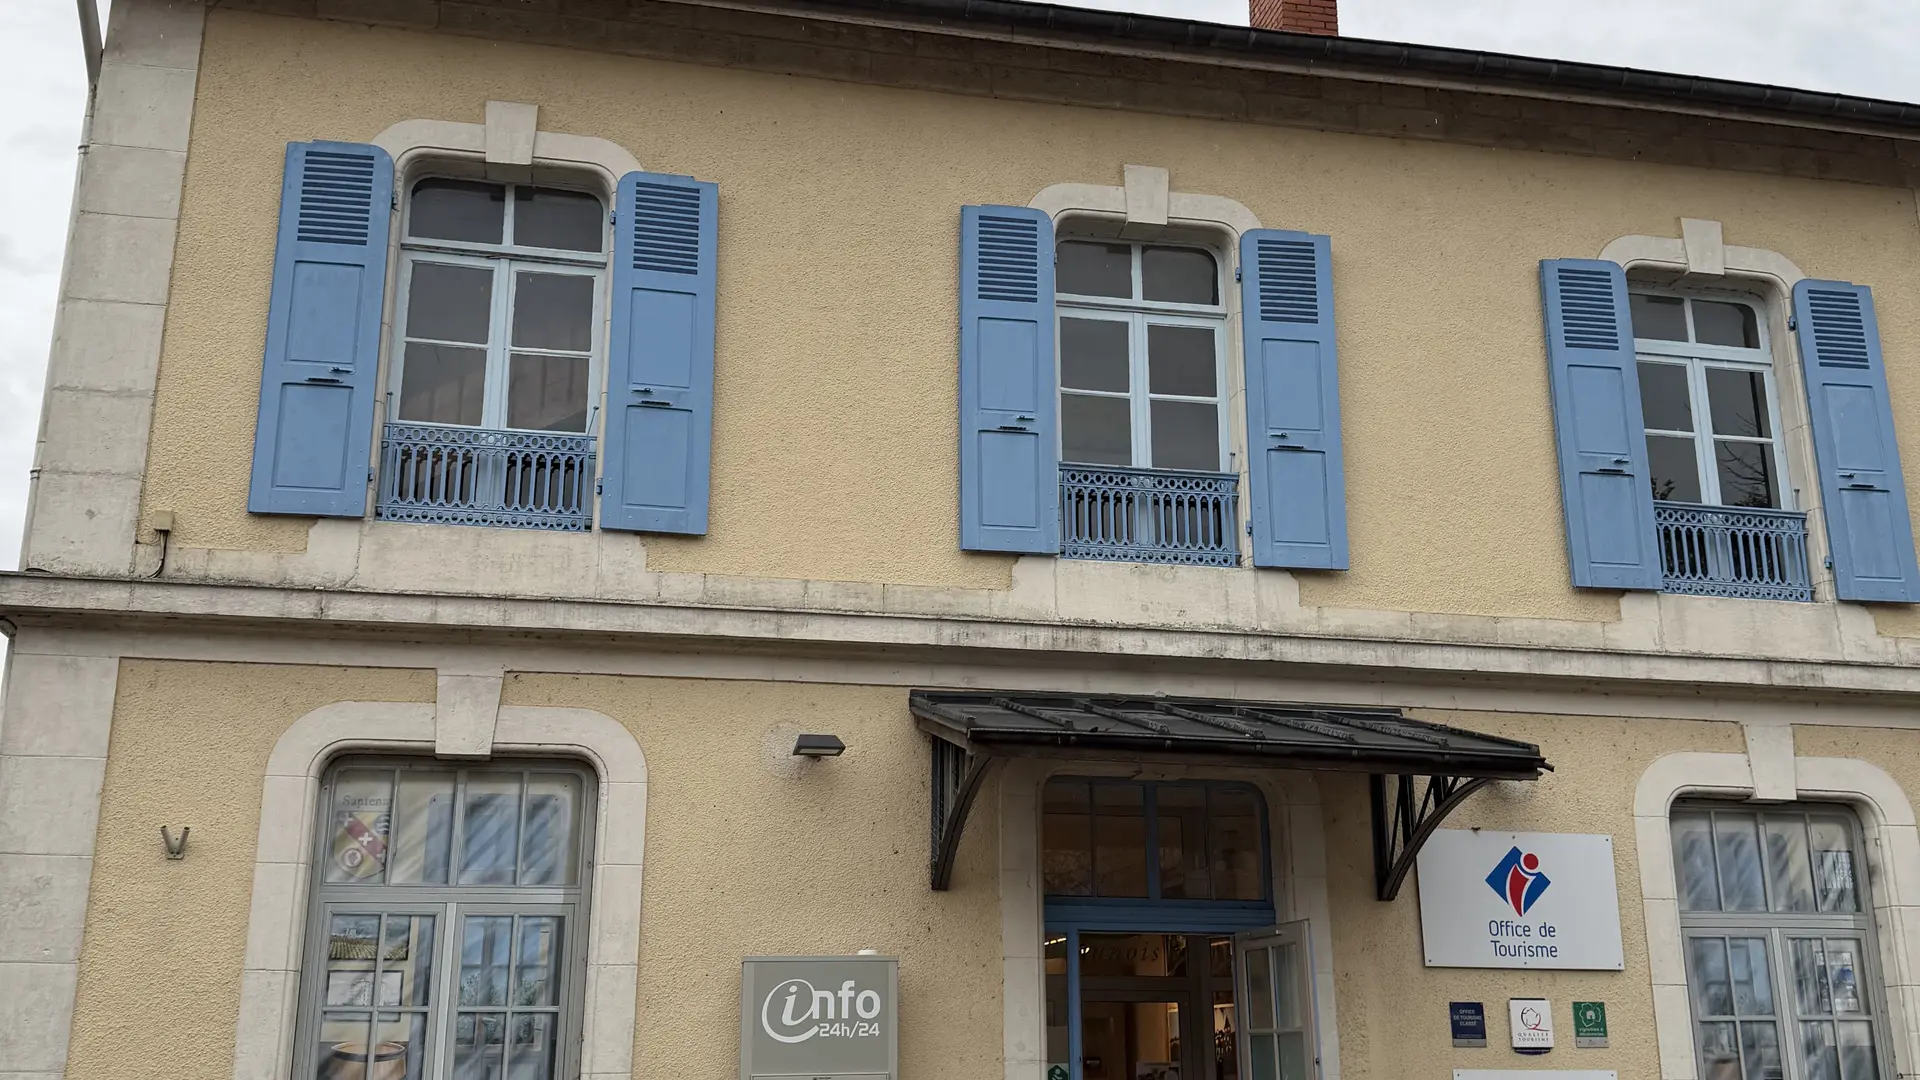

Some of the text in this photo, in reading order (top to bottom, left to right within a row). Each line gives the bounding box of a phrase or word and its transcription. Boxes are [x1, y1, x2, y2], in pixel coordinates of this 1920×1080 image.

[1489, 920, 1556, 938] Office de
[1490, 940, 1558, 958] Tourisme
[761, 978, 881, 1043] info
[819, 1021, 880, 1038] 24h/24
